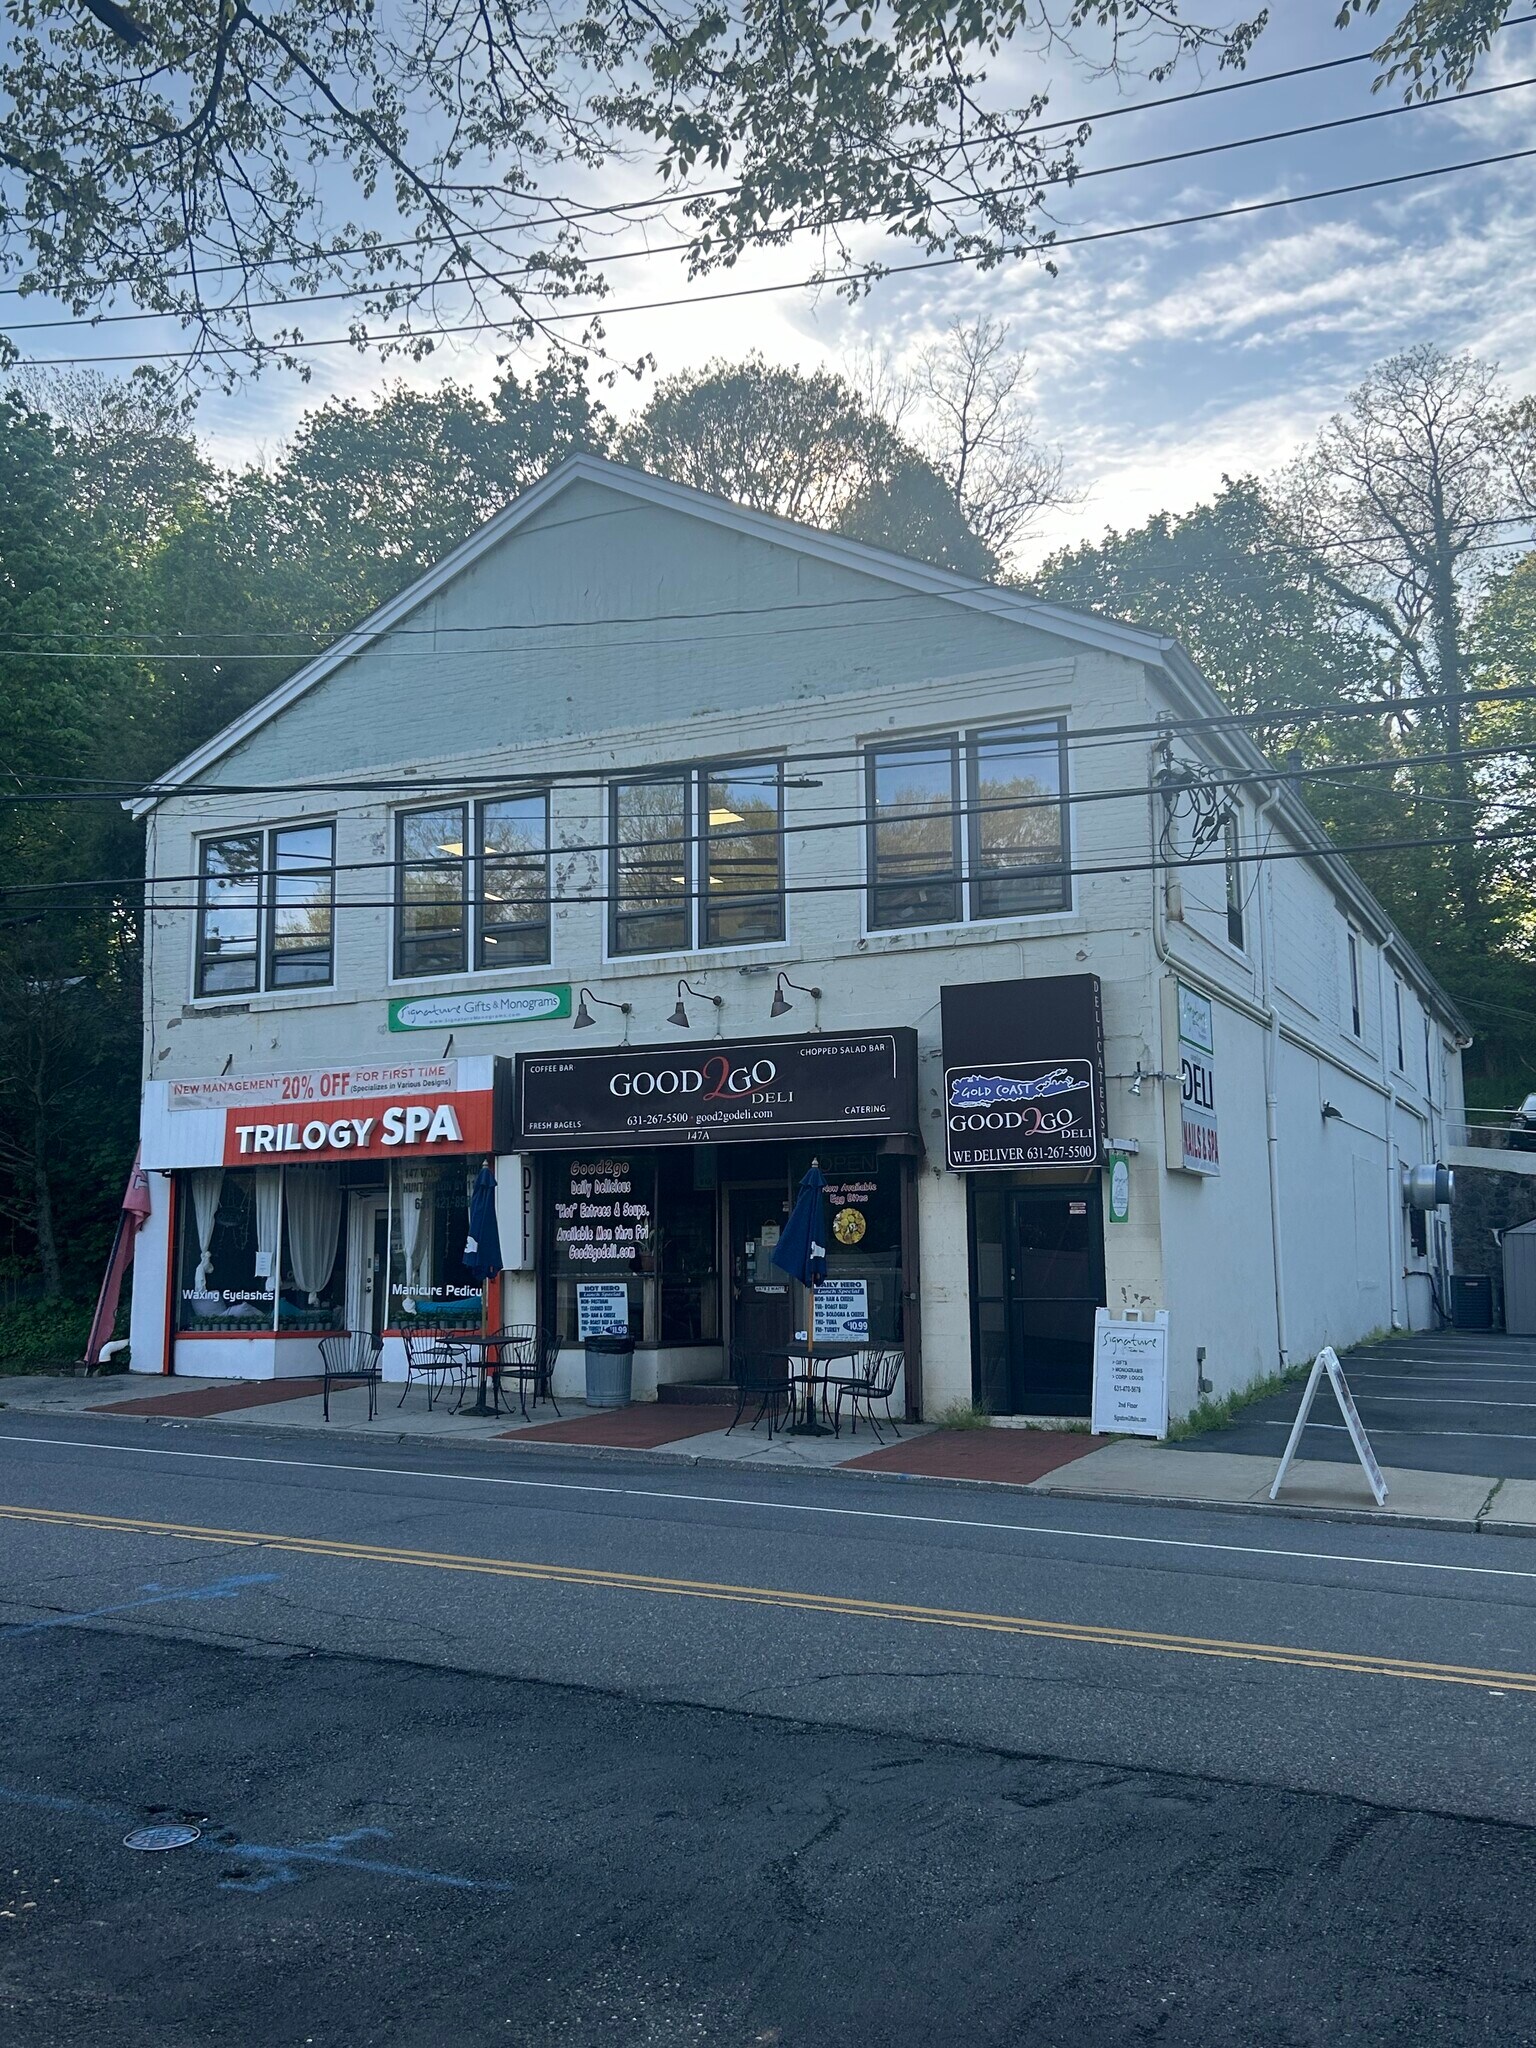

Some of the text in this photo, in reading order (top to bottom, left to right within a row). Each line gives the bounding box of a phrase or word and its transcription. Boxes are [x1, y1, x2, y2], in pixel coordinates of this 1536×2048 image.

[401, 1005, 461, 1023] Signature
[464, 1000, 491, 1013] Gifts
[500, 997, 558, 1011] Monograms
[800, 1044, 885, 1057] CHOPPED SALAD BAR
[530, 1064, 574, 1073] COFFEE BAR
[174, 1066, 446, 1099] NEW MANAGEMENT 20% OFF FOR FIRST TIME
[351, 1084, 388, 1094] (Specializes
[423, 1079, 451, 1088] Designs)
[1182, 1058, 1213, 1110] DELI
[752, 1092, 793, 1104] DELI
[962, 1084, 1031, 1098] GOLD COAST
[627, 1109, 773, 1125] 631-267-5500 good2godeli.com
[845, 1105, 886, 1114] CATERING
[236, 1105, 463, 1154] TRILOGY SPA
[554, 1121, 582, 1129] BAGELS
[688, 1131, 710, 1140] 147A
[1062, 1129, 1093, 1139] DELI
[1184, 1121, 1220, 1165] NAILS & SPA
[954, 1146, 1092, 1163] WE DELIVER 631-267-5500
[571, 1160, 630, 1178] Good2go
[571, 1179, 631, 1198] Daily Delicious
[841, 1182, 877, 1192] Available
[847, 1193, 869, 1203] Bites
[523, 1167, 531, 1261] DELI
[555, 1203, 578, 1219] "Hot"
[580, 1203, 612, 1218] Entrees
[614, 1202, 620, 1217] &
[557, 1224, 649, 1241] Available Mon thru Fri
[183, 1290, 274, 1302] Waxing Eyelashes
[392, 1284, 482, 1297] Manicure Pedicu
[847, 1322, 868, 1331] $10.99
[1103, 1332, 1157, 1355] Signature
